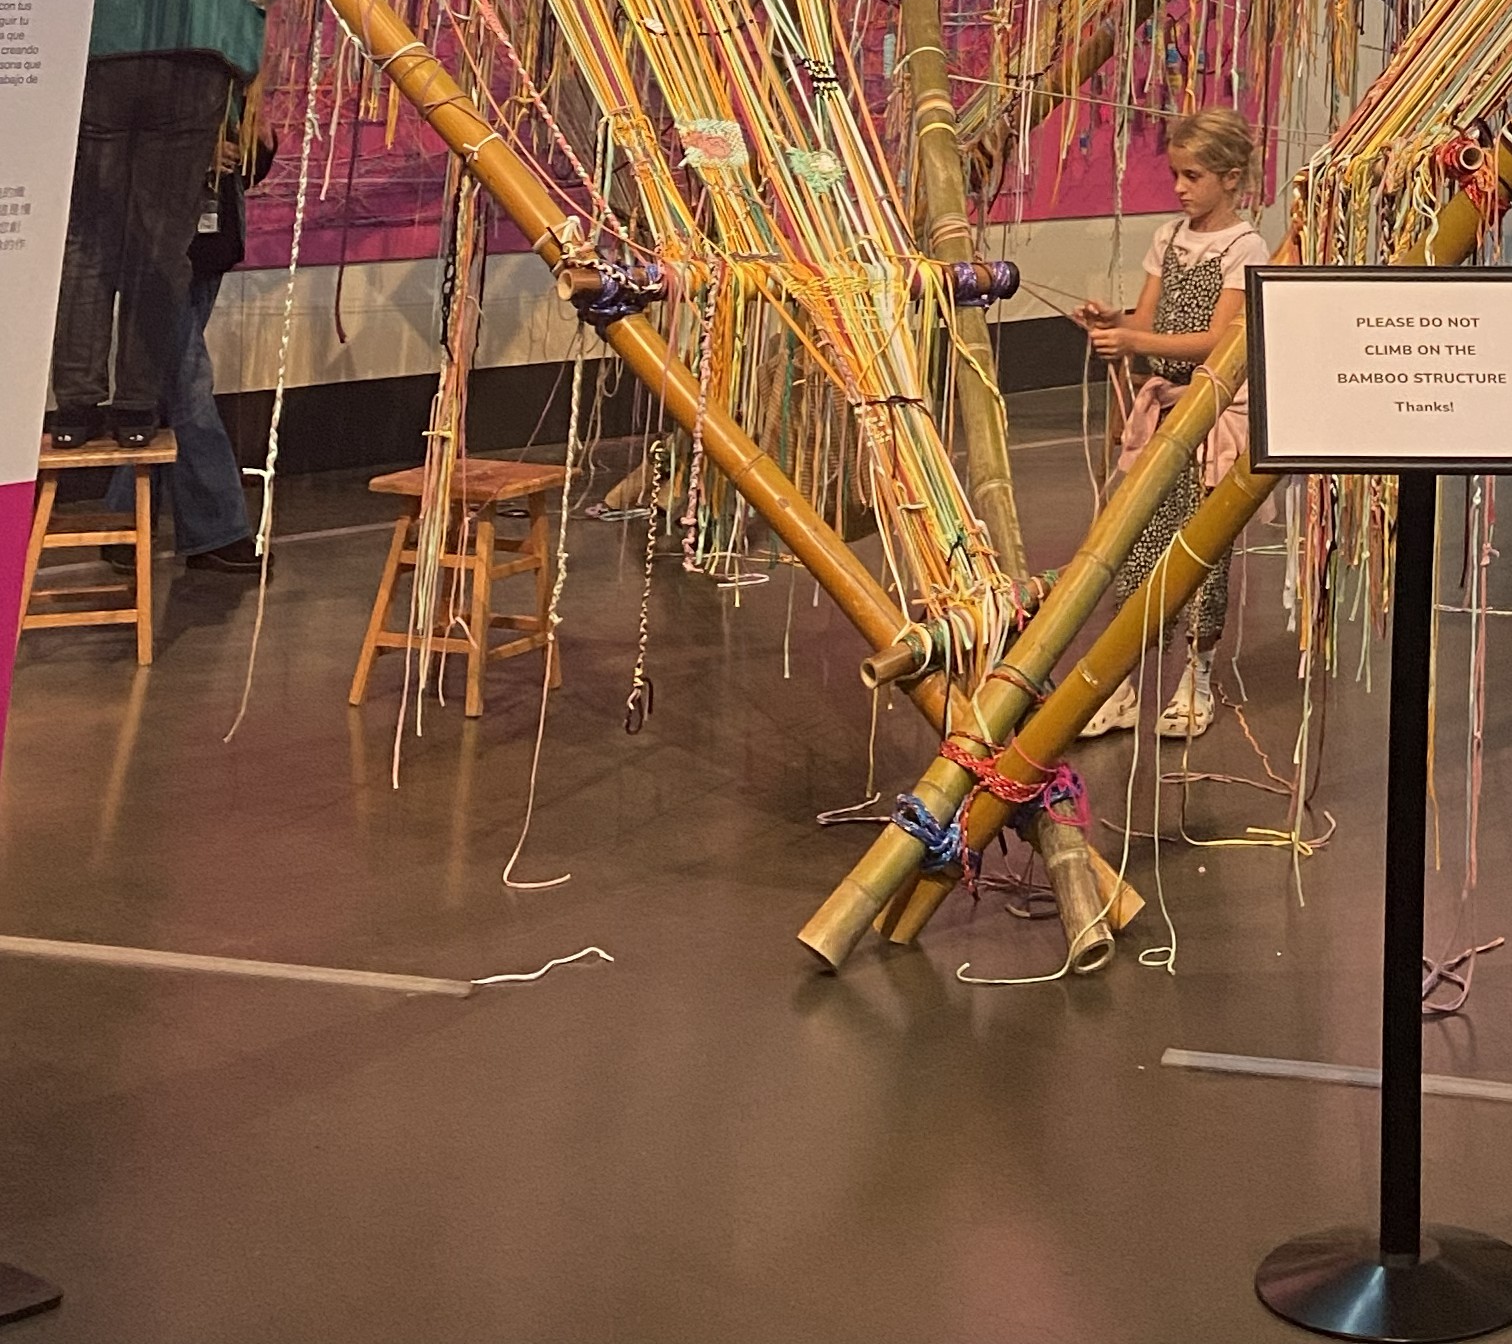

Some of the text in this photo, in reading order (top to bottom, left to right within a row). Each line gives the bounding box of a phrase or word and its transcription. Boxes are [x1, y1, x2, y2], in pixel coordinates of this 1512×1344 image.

[18, 2, 31, 10] tus
[20, 16, 29, 25] tu
[7, 32, 25, 41] que
[24, 61, 41, 70] que
[26, 74, 38, 83] de
[1356, 317, 1480, 328] PLEASE DO NOT
[1364, 344, 1477, 355] CLIMB ON THE
[1337, 373, 1507, 384] BAMBOO STRUCTURE
[1394, 401, 1454, 412] Thanks!
